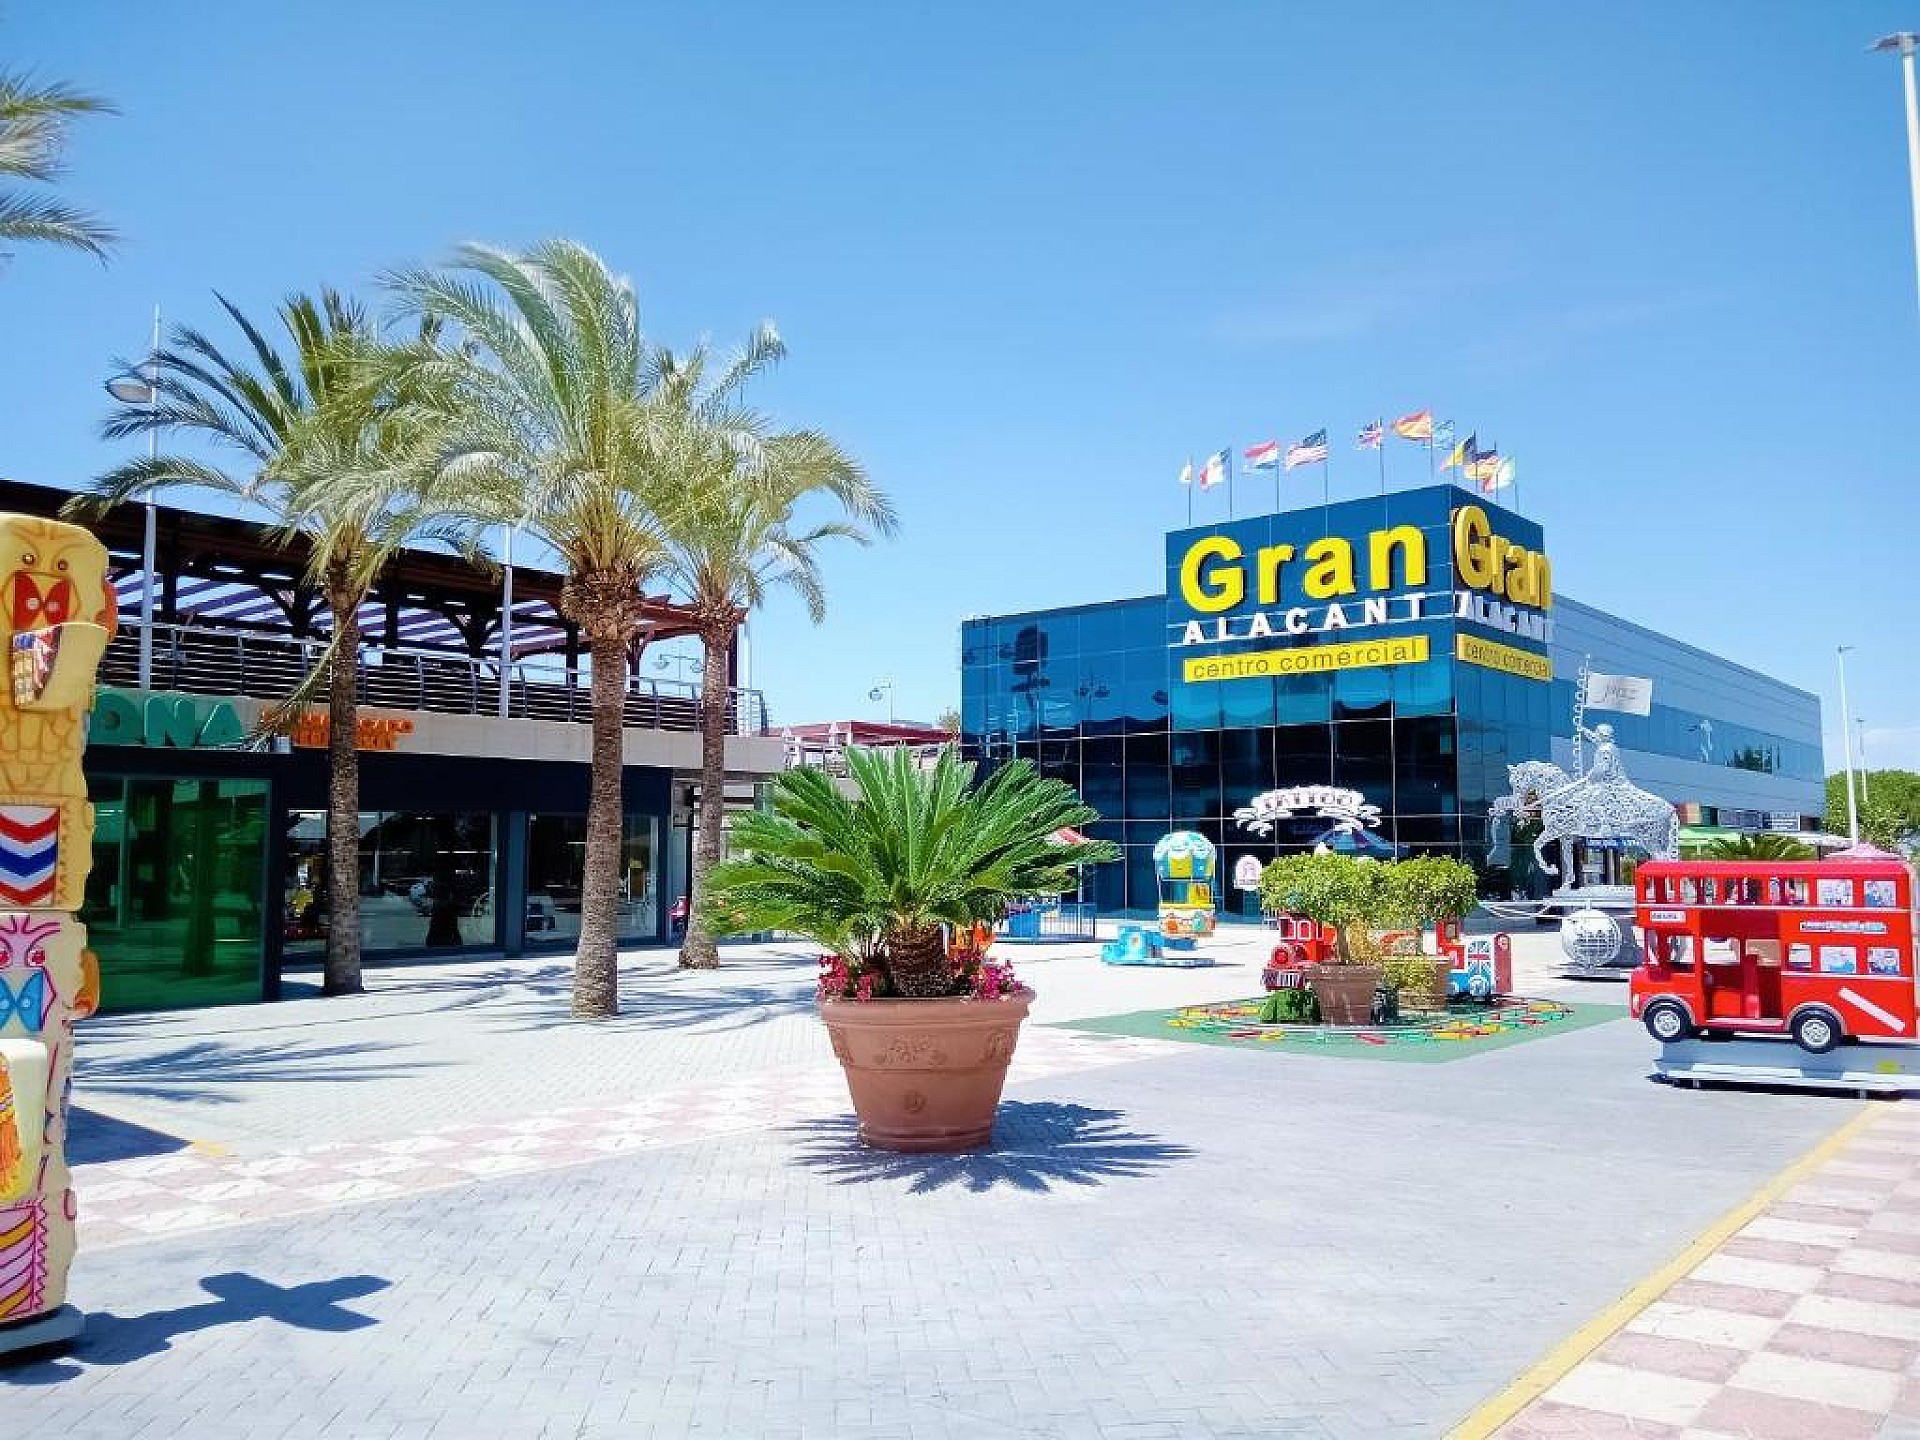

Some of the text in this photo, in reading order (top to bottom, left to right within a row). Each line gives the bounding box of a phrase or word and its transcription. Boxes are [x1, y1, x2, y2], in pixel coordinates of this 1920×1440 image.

[1180, 524, 1426, 613] Gran
[1453, 505, 1552, 610] Gran
[1183, 593, 1426, 646] ALACANT
[1193, 640, 1417, 679] centro comercial
